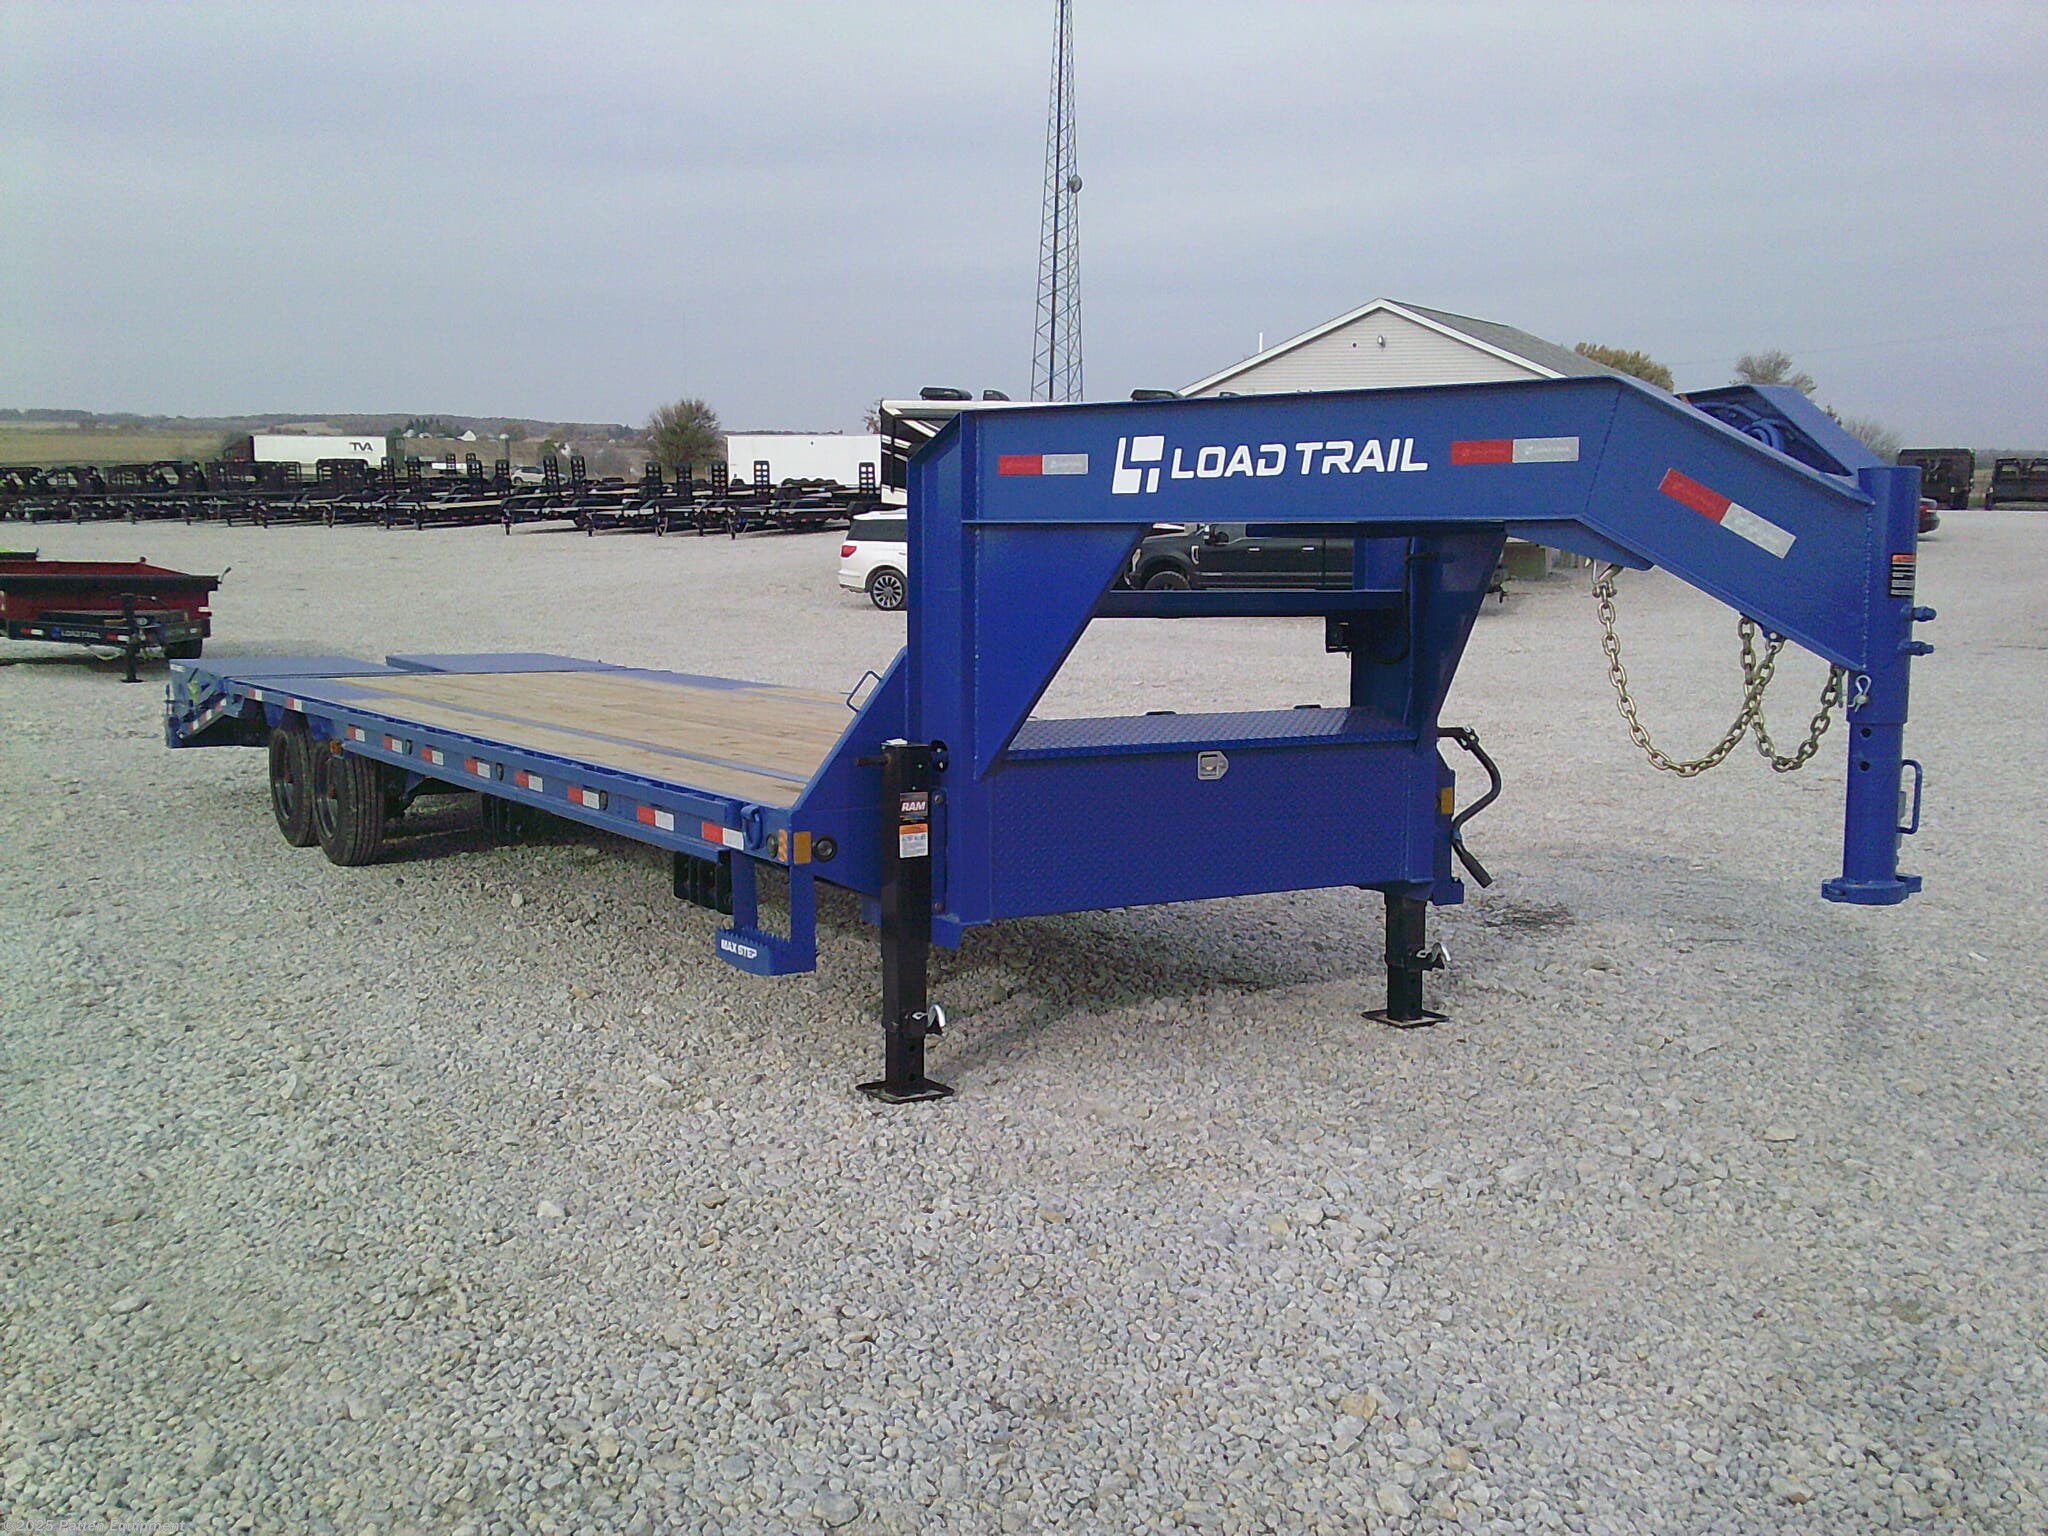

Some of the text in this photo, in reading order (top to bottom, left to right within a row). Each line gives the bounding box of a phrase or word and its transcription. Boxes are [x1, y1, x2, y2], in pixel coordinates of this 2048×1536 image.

[349, 441, 374, 451] TVA
[1170, 443, 1287, 479] LOAD
[1295, 437, 1428, 475] TRAIL
[901, 801, 926, 812] RAM
